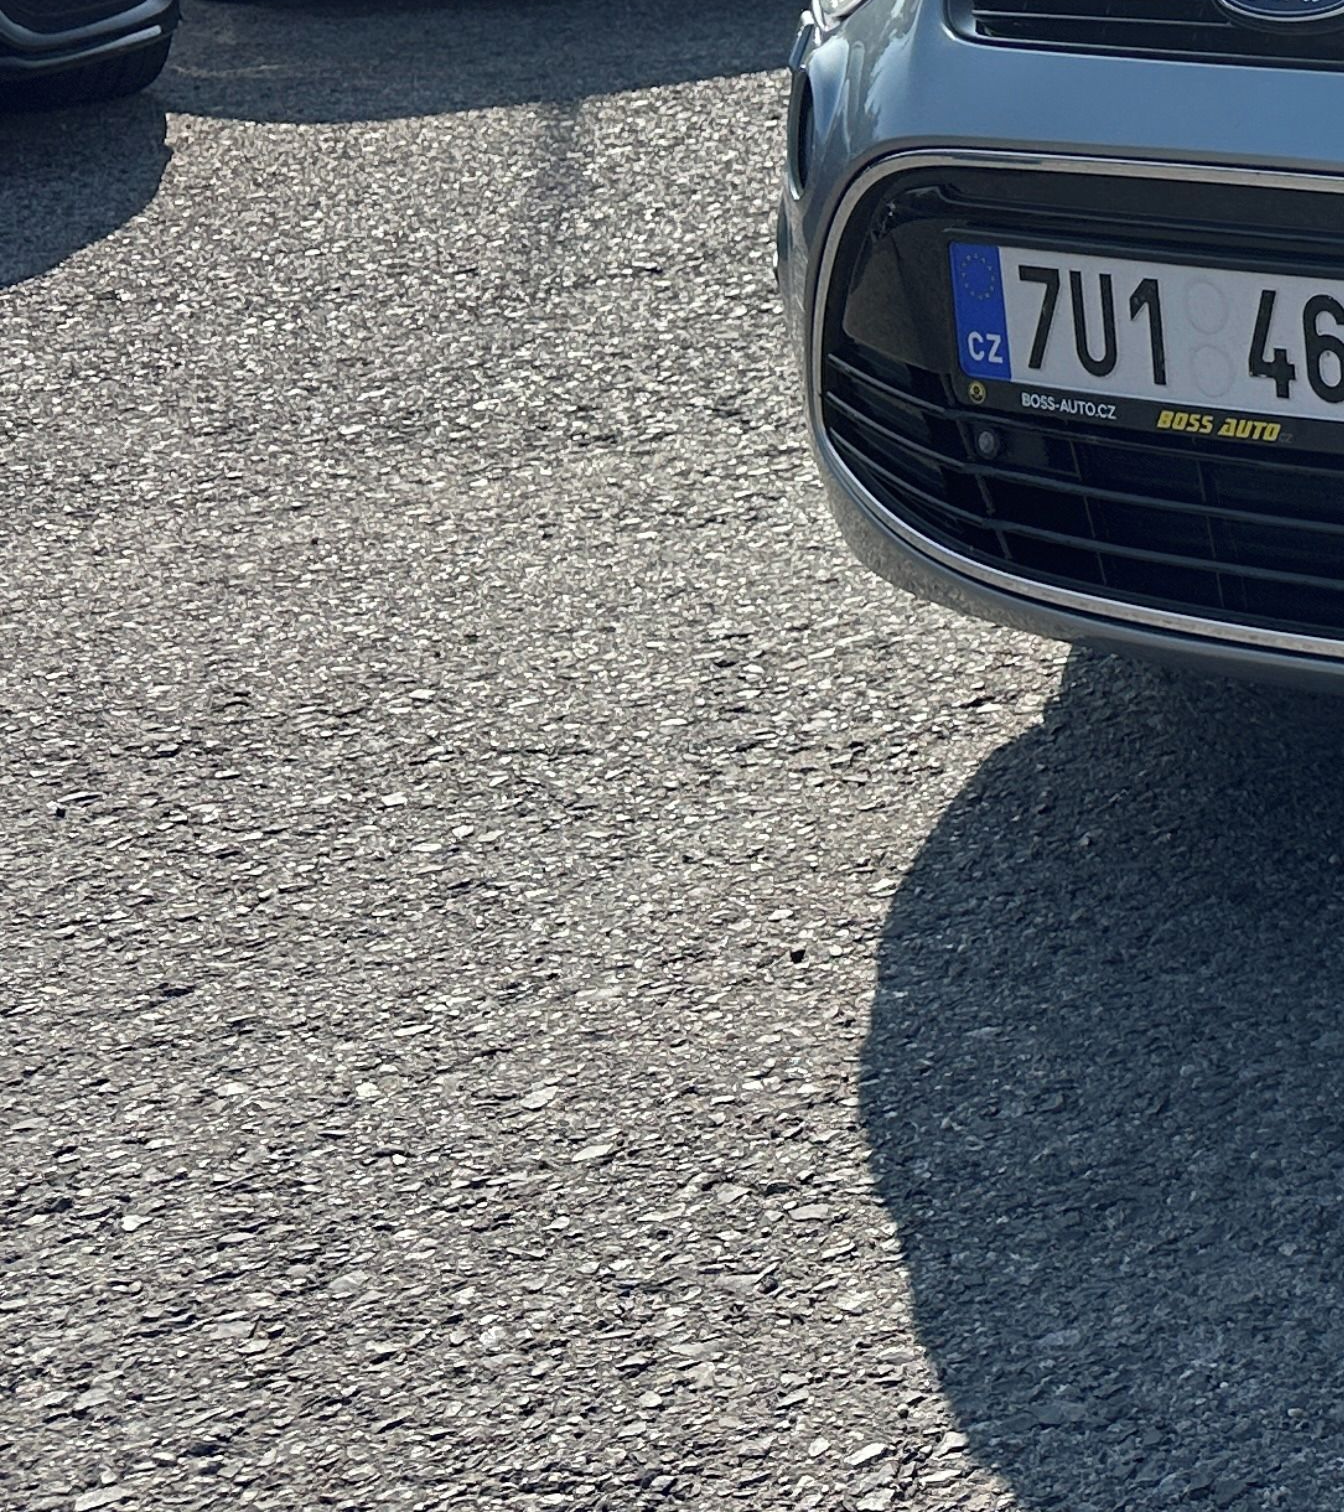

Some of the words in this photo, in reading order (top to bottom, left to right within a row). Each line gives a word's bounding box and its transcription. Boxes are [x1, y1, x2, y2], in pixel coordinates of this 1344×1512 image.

[1017, 264, 1168, 386] 7U1
[967, 330, 1004, 365] CZ
[1021, 392, 1117, 421] BOSS-AUTO.CZ
[1156, 410, 1215, 435] BOSS
[1217, 417, 1282, 443] AUTO
